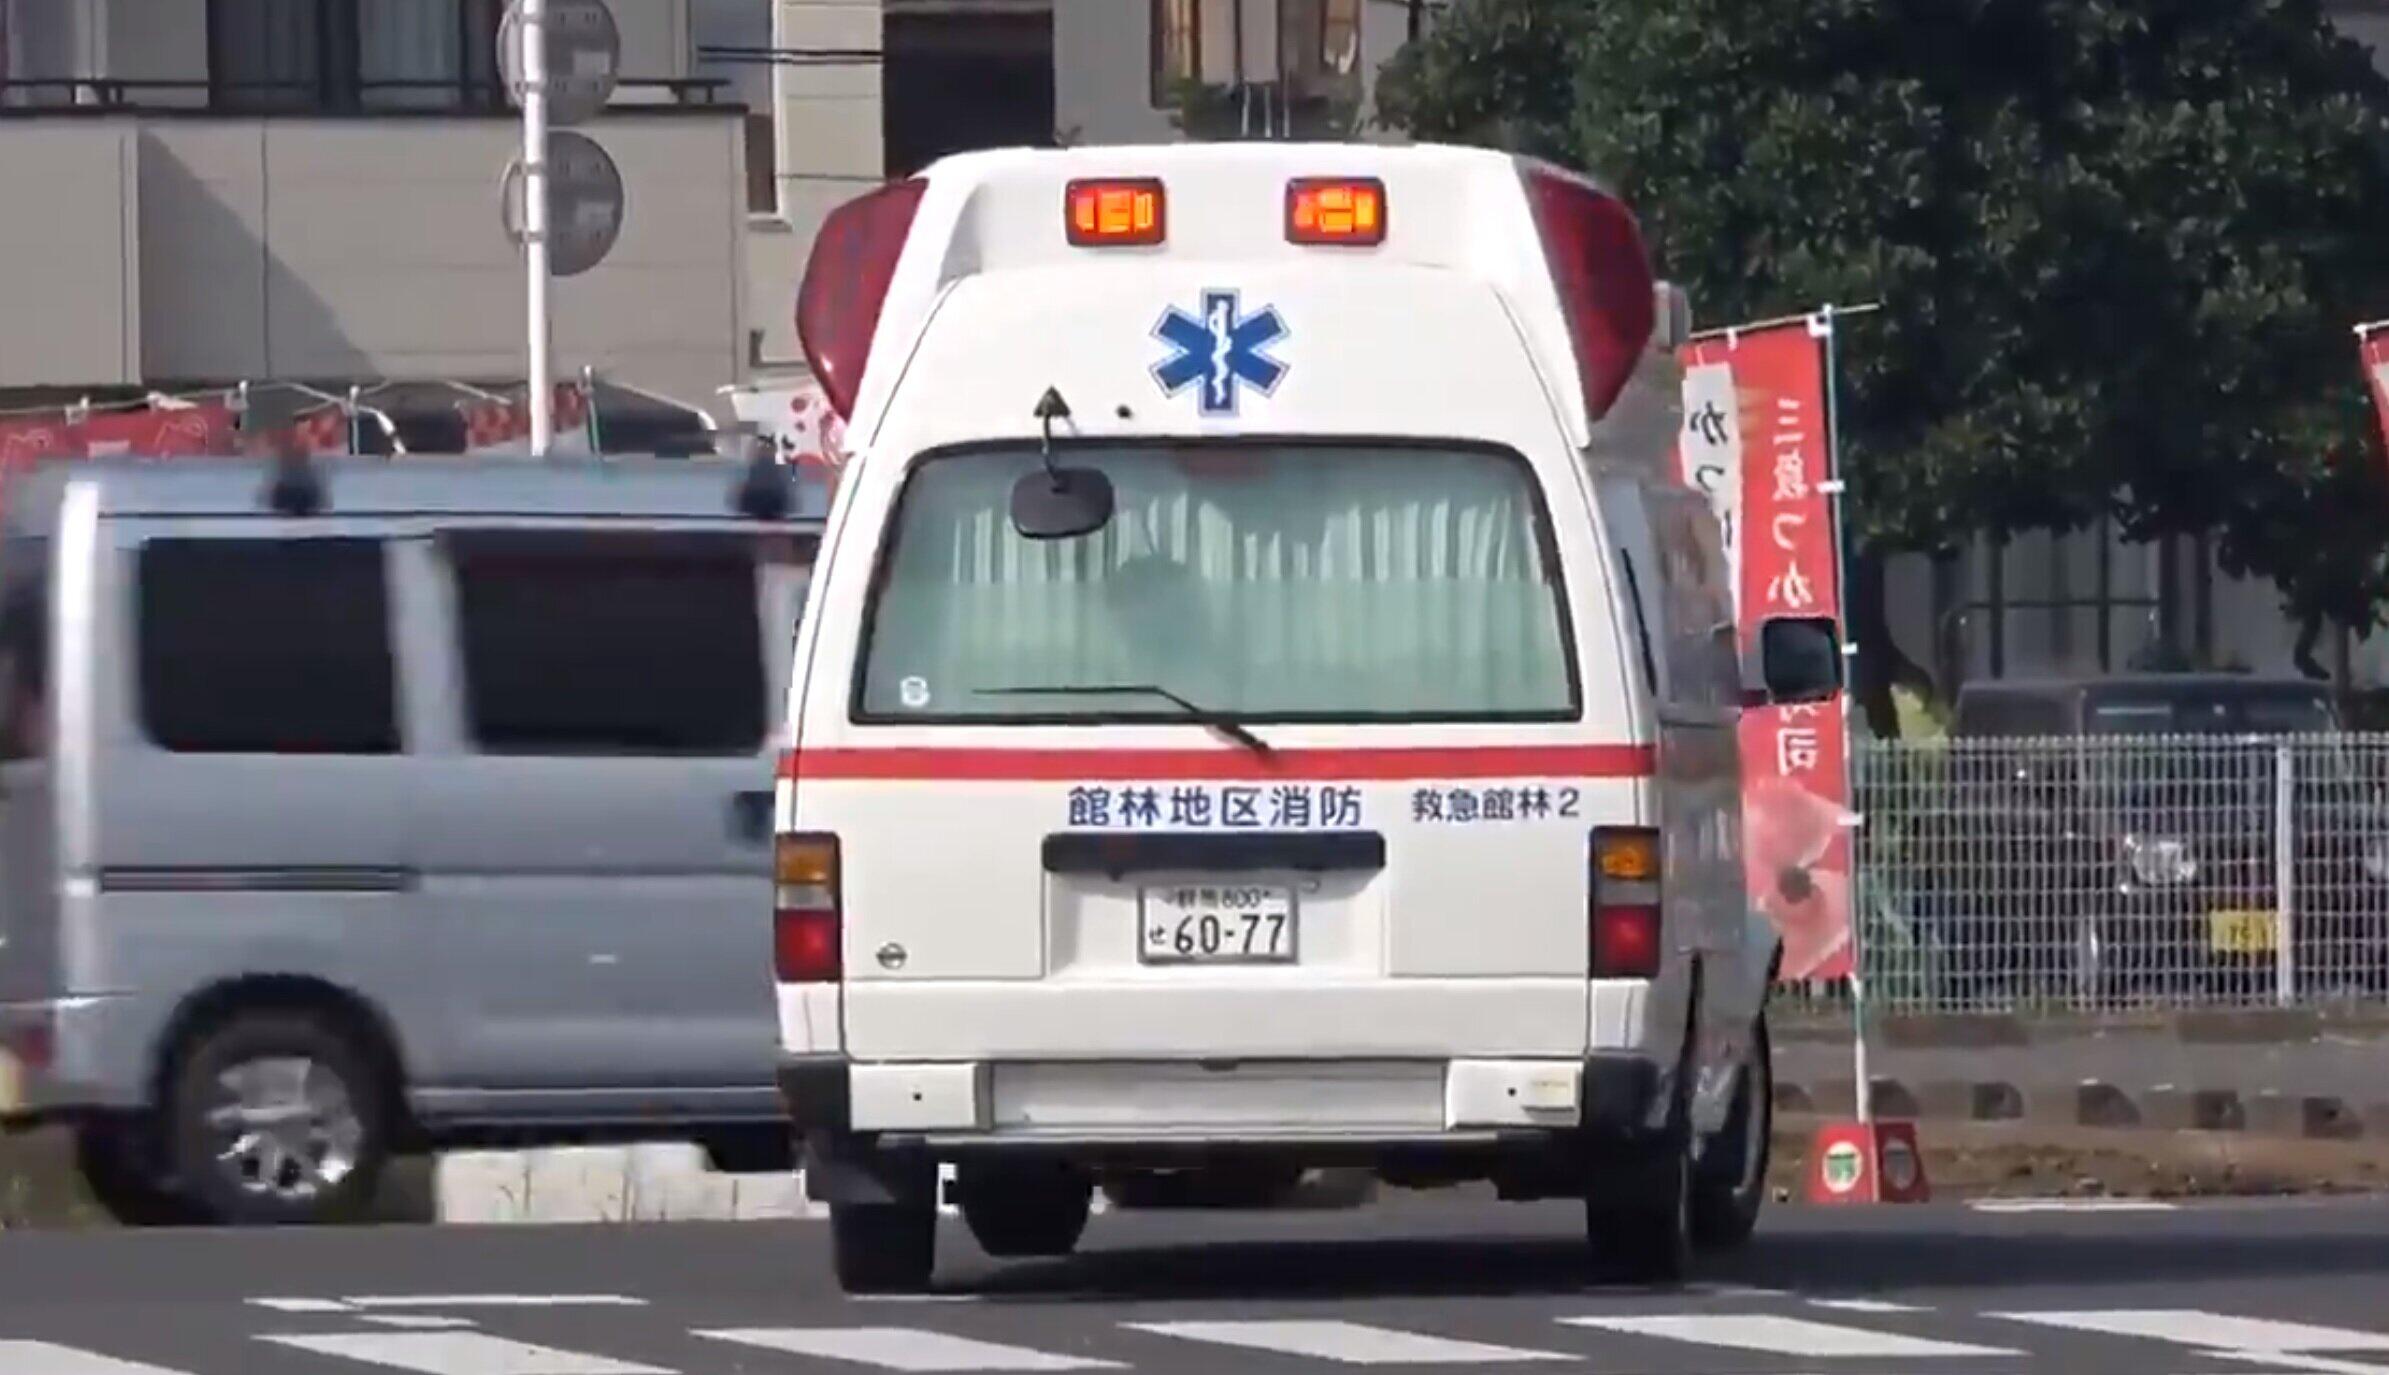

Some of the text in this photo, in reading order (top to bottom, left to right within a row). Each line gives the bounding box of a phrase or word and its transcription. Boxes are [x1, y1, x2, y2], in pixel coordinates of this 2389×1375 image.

[1068, 785, 1362, 827] 館林地区消防
[1174, 913, 1286, 954] 60-77
